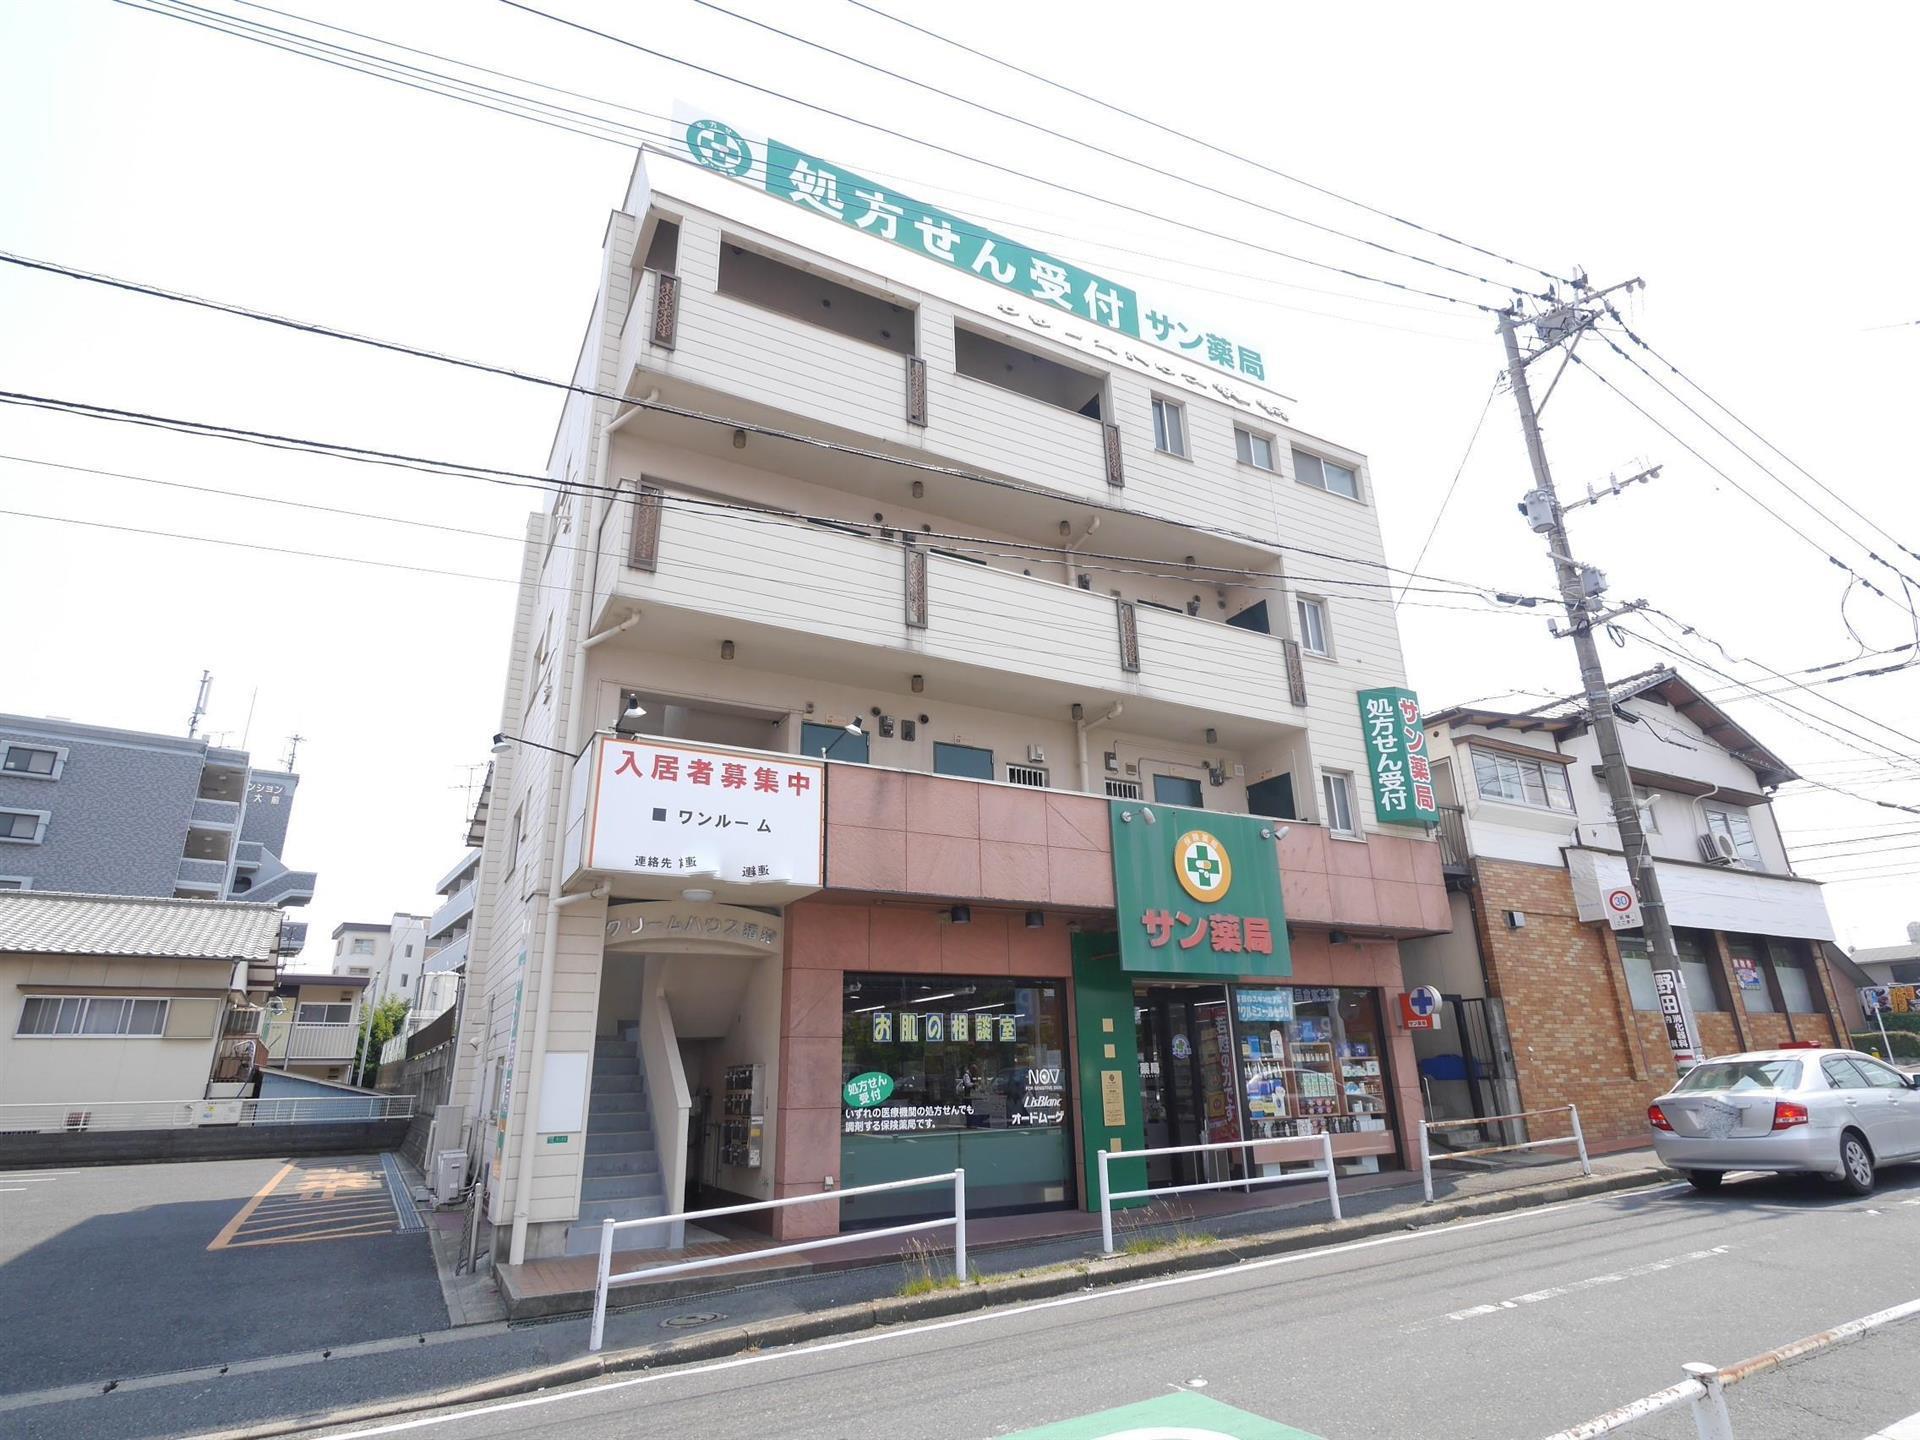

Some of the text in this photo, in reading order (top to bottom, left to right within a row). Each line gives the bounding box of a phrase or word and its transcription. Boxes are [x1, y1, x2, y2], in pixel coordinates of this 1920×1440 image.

[789, 158, 1126, 330] 処方せん受付
[1145, 310, 1265, 382] サン薬局
[1366, 698, 1408, 812] 処方せん受付
[1398, 697, 1436, 812] サン薬局
[614, 749, 811, 797] 入居者募集中
[678, 809, 772, 833] ワンルーム
[1614, 895, 1628, 907] 30
[1141, 909, 1274, 955] サン薬局
[1655, 974, 1679, 1014] 野田
[873, 1012, 1017, 1043] お肌の相談室
[847, 1075, 888, 1096] 処方せん
[1028, 1068, 1060, 1085] NOV
[858, 1089, 882, 1105] 受付
[1024, 1095, 1062, 1108] LisBlanc
[845, 1105, 975, 1120] いずれの医療機関の処方せんでも
[1011, 1110, 1065, 1125] オードムーゲ
[845, 1118, 936, 1133] 調剤する保険薬局です。
